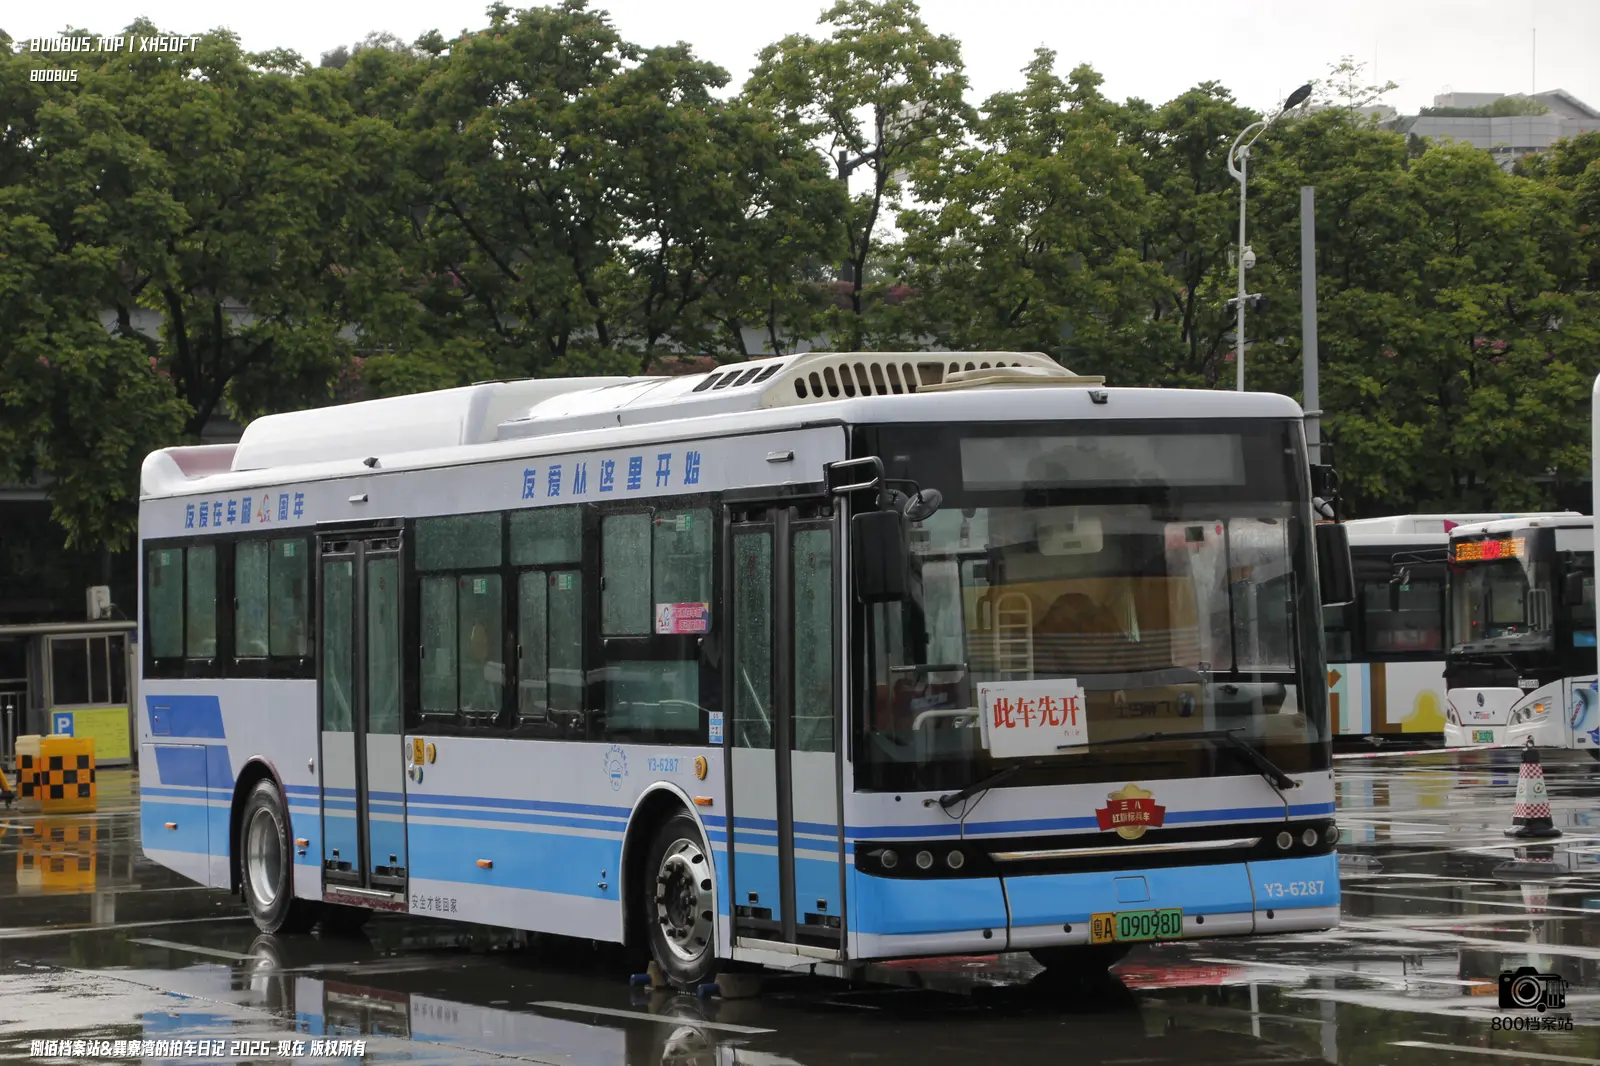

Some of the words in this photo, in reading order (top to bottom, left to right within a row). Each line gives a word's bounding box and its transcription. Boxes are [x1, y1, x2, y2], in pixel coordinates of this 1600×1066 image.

[521, 450, 701, 500] 友爱从这里开始
[993, 695, 1080, 729] 此车先开
[57, 716, 71, 734] P
[647, 758, 680, 773] Y3-6287
[1263, 880, 1325, 898] Y3-6287
[411, 894, 458, 914] 安全才能回家
